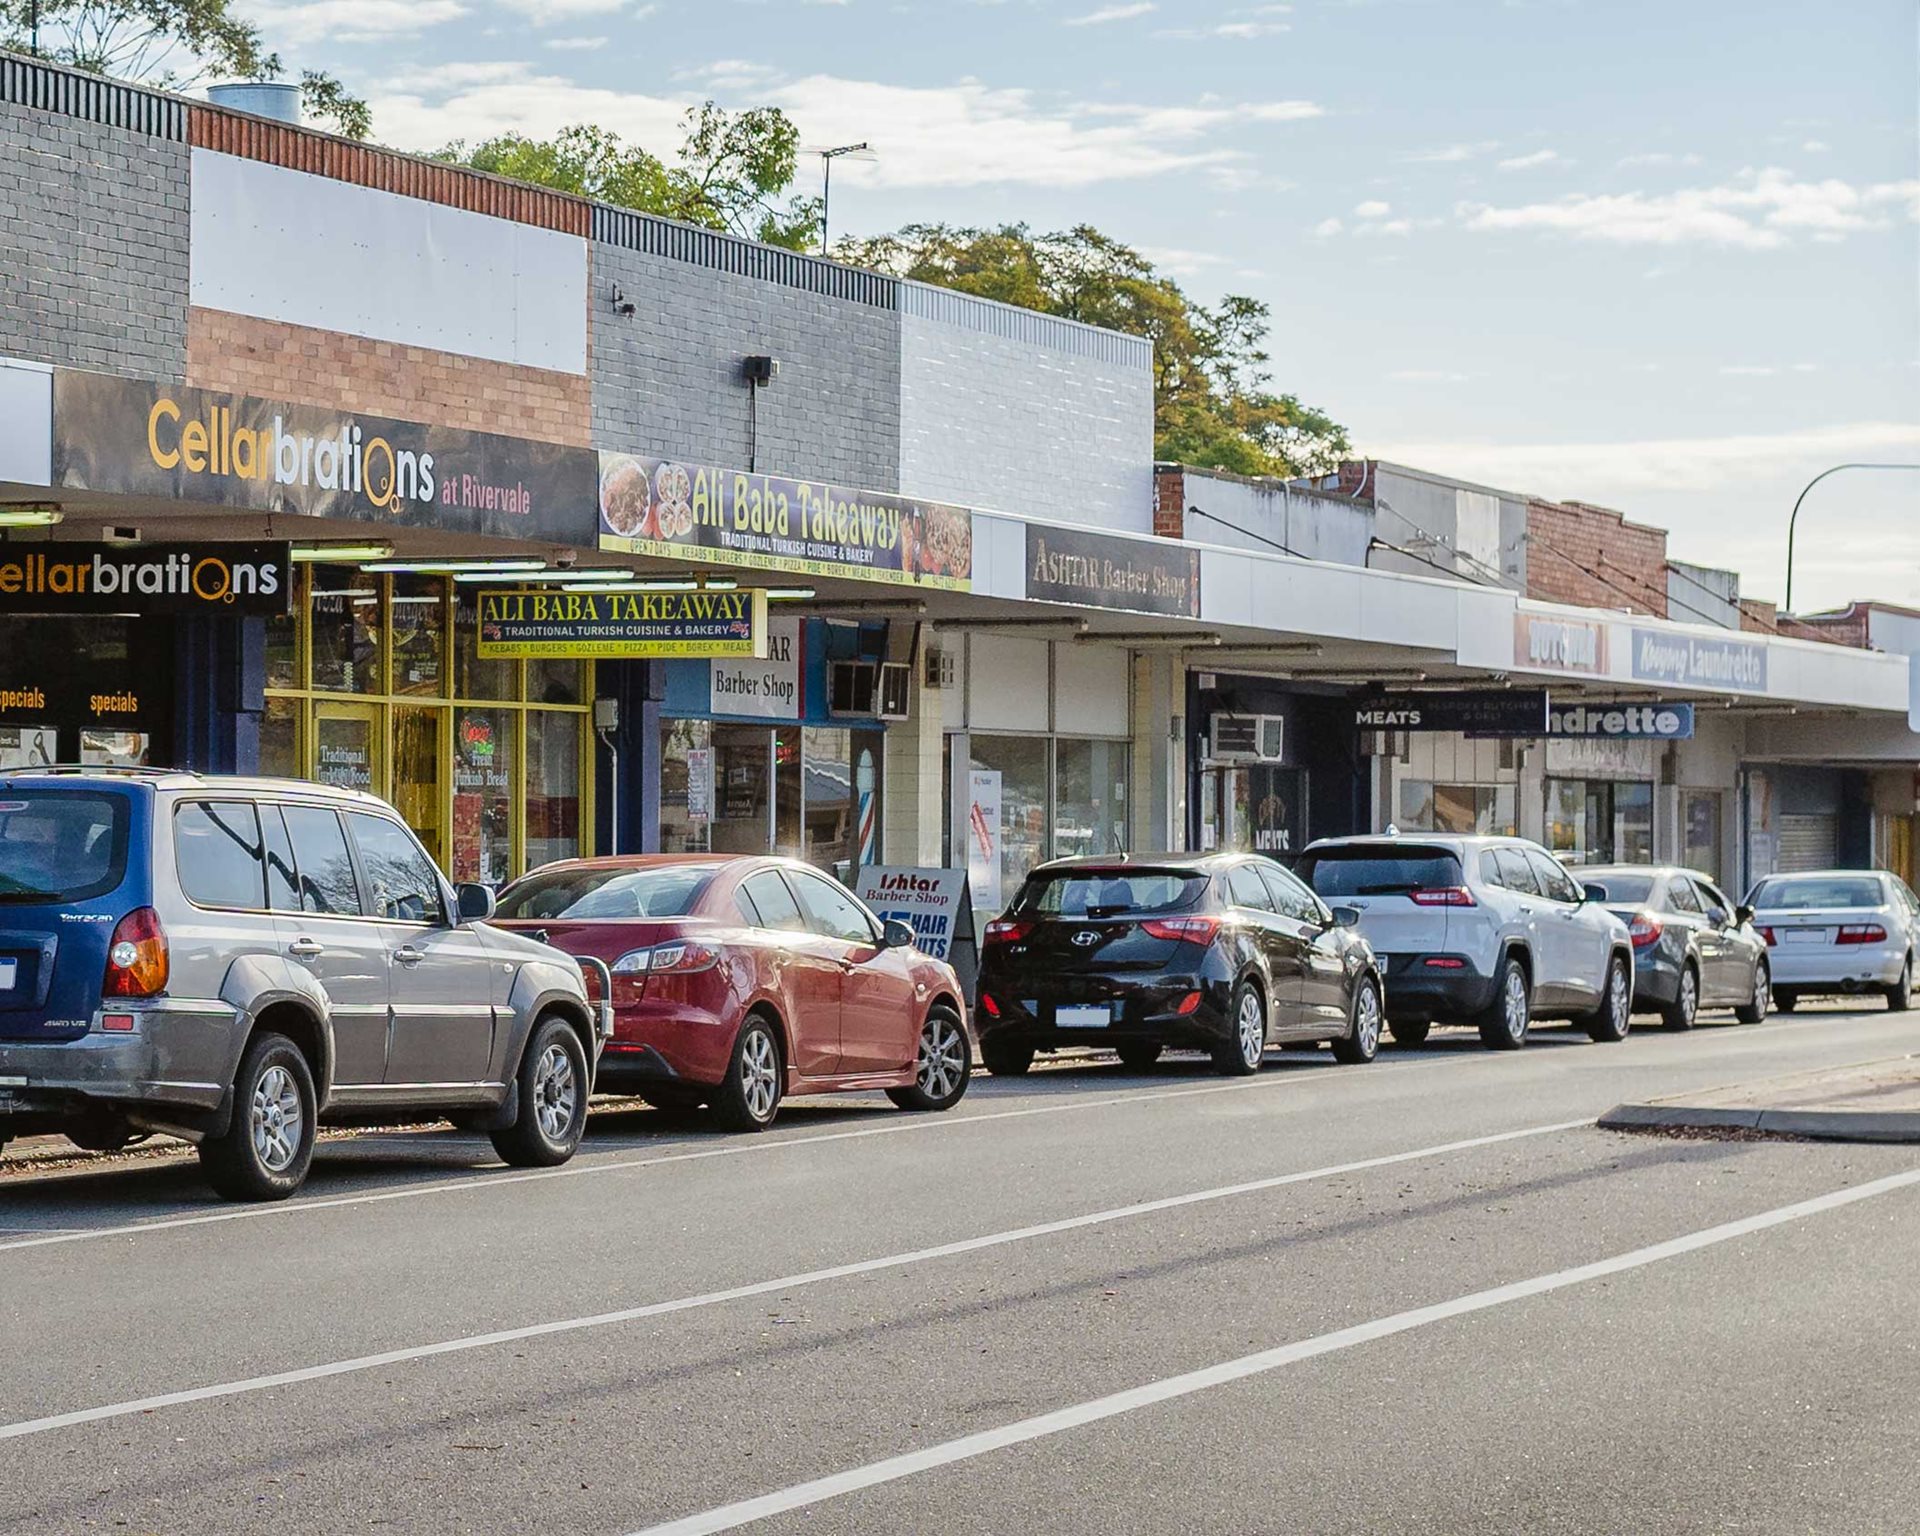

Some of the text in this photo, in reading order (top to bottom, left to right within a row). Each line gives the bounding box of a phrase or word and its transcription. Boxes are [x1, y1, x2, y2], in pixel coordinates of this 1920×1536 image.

[442, 479, 458, 505] at
[462, 474, 530, 515] Rivervale
[692, 467, 899, 550] Ali Baba Takeaway
[630, 540, 648, 553] OPEN
[655, 543, 671, 556] DAYS
[682, 547, 707, 561] KEBABS
[713, 550, 742, 565] BURGERS
[783, 559, 801, 571] PIZZA
[806, 561, 821, 573] PIDE
[827, 564, 846, 576] BOREK
[852, 567, 871, 579] MEALS
[720, 531, 874, 563] TRADITIONAL TURKISH CUISINE & BAKERY
[1103, 560, 1149, 594] Barber
[1153, 566, 1186, 608] Shop
[484, 596, 525, 620] ALI
[533, 595, 599, 620] BABA
[605, 593, 748, 620] TAKEAWAY
[505, 625, 729, 636] TRADITIONAL TURKISH CUISINE & BAKERY
[490, 642, 752, 653] KEBABS BURGERS GOZLEME PIZZA PIDE BOREK MEALS
[1689, 640, 1760, 683] Laundrette
[0, 686, 45, 712] pecials
[716, 670, 793, 704] Barber Shop
[90, 690, 138, 716] specials
[1356, 711, 1421, 724] MEATS
[320, 745, 366, 763] Traditional
[880, 873, 941, 891] Ishtar
[865, 889, 948, 906] Barber Shop
[911, 914, 948, 935] HAIR
[912, 937, 947, 958] UTS
